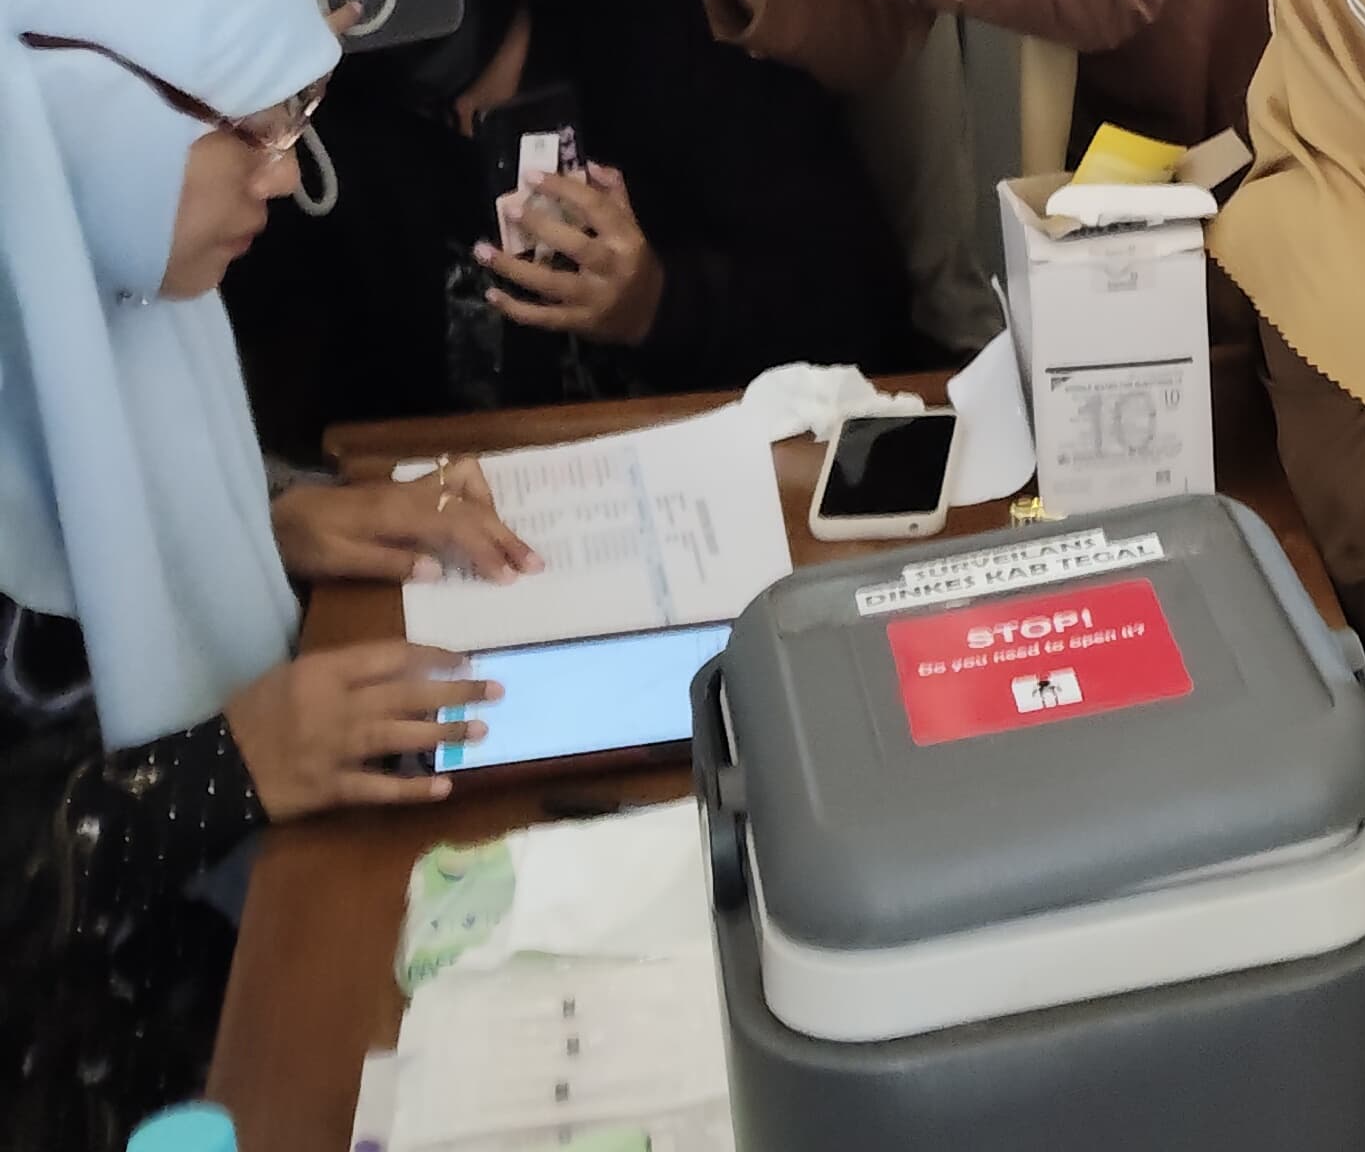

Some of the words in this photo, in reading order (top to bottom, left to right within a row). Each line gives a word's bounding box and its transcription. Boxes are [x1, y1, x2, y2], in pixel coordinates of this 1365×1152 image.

[864, 574, 976, 608] DINKES
[986, 563, 1047, 584] KAB
[1056, 544, 1156, 570] TEGAL
[916, 538, 1097, 580] SURVEILANS
[966, 607, 1094, 649] STOP!
[951, 656, 988, 673] you
[993, 642, 1041, 663] need
[1044, 639, 1065, 653] to
